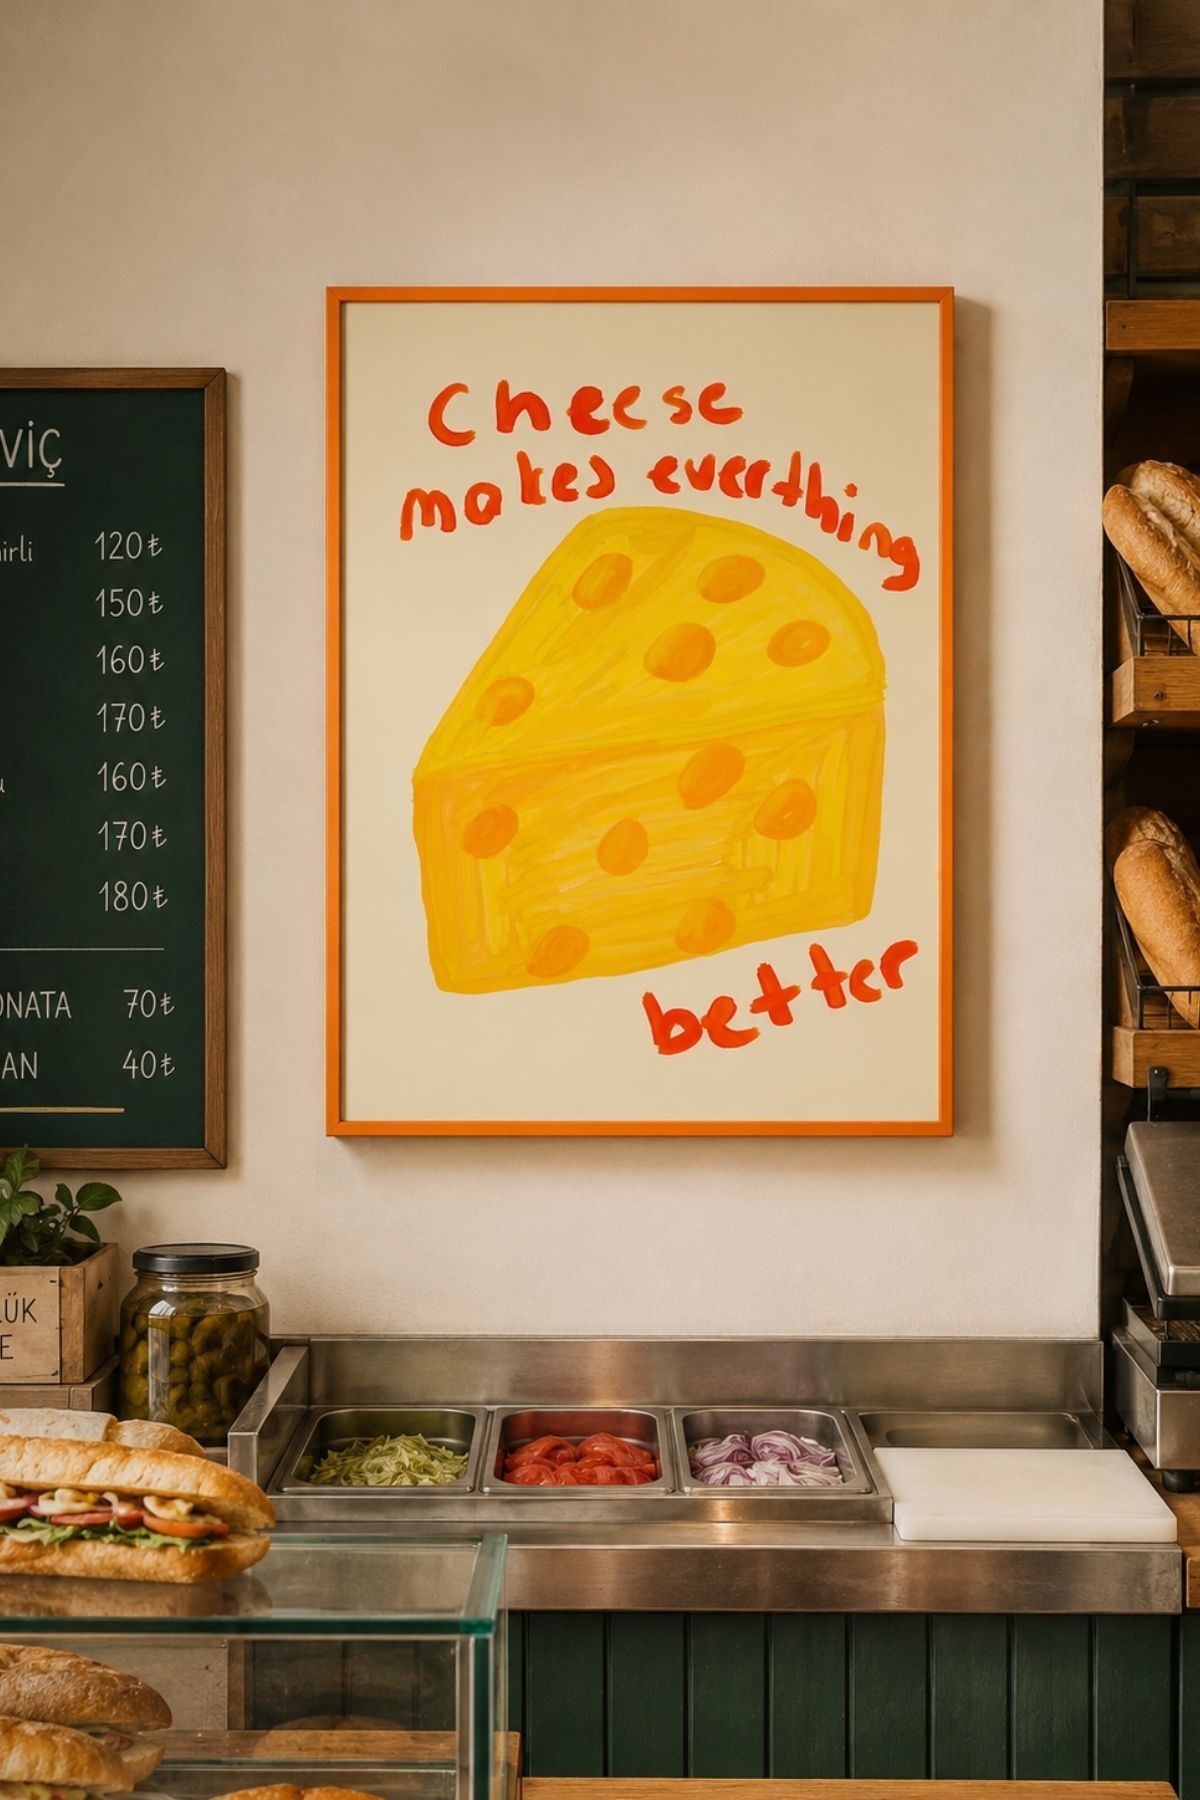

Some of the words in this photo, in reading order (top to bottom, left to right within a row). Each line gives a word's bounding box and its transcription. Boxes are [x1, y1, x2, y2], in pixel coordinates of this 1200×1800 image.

[400, 450, 616, 541] makes
[0, 534, 33, 562] irli
[94, 531, 163, 561] 120₺
[95, 588, 164, 618] 150₺
[96, 644, 165, 675] 160₺
[96, 702, 166, 733] 170₺
[97, 761, 167, 792] 160₺
[97, 820, 168, 851] 170₺
[98, 880, 169, 912] 180₺
[123, 988, 175, 1019] 70₺
[642, 940, 918, 1055] better
[122, 1049, 176, 1080] 40₺
